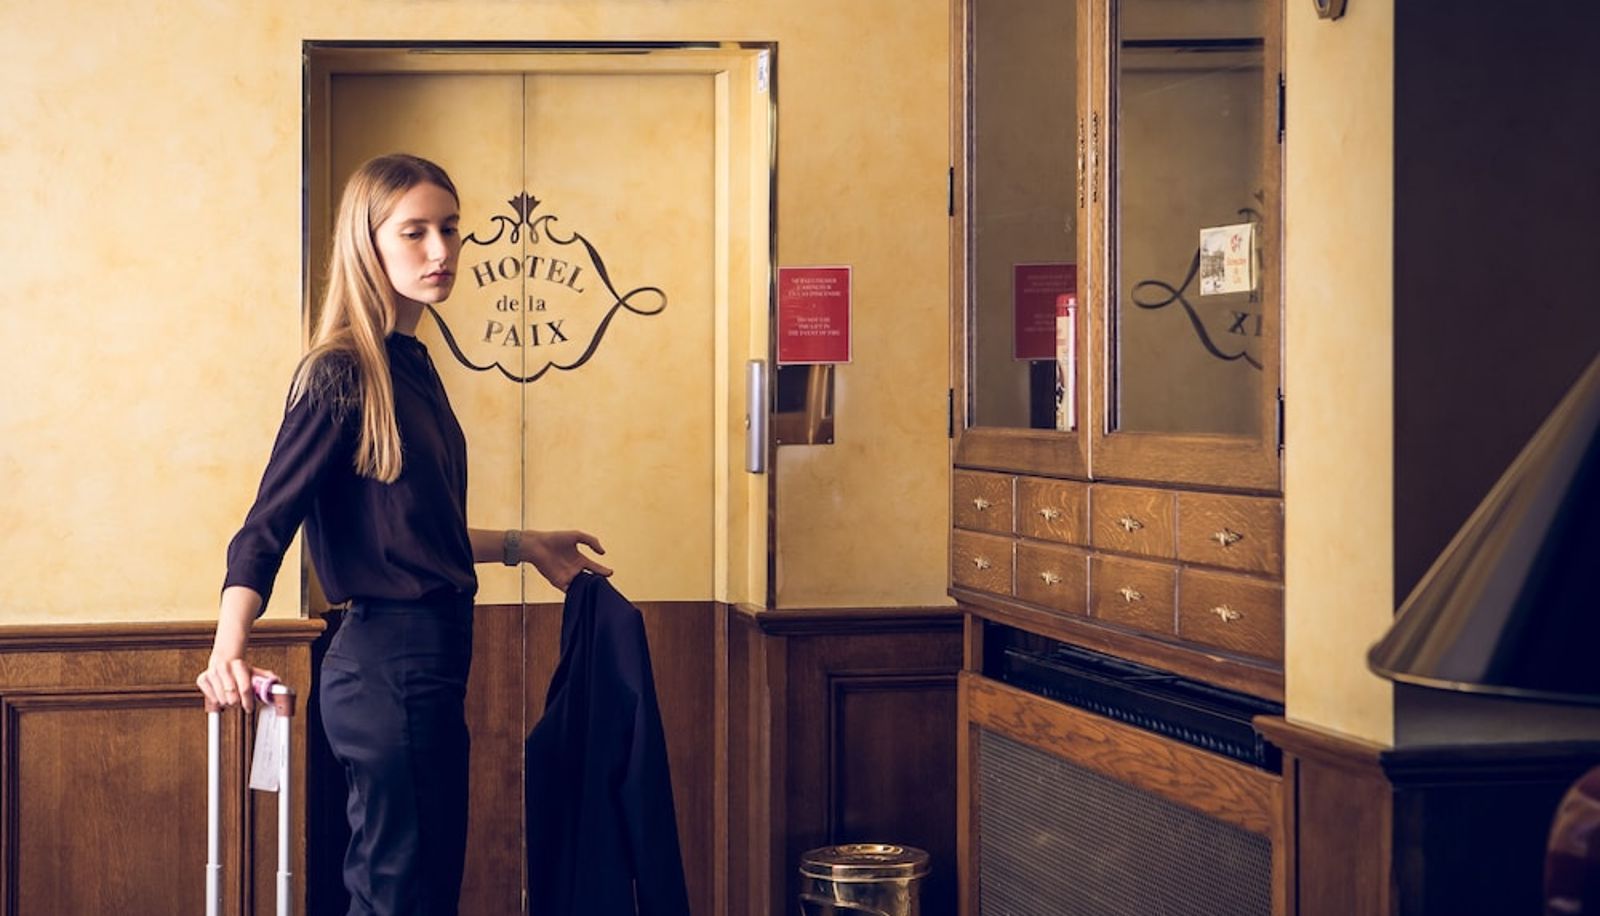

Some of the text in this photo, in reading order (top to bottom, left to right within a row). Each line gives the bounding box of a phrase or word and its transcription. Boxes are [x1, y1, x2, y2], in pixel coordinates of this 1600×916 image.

[471, 255, 584, 294] HOTEL
[496, 295, 546, 312] de la
[482, 319, 568, 347] PAIX
